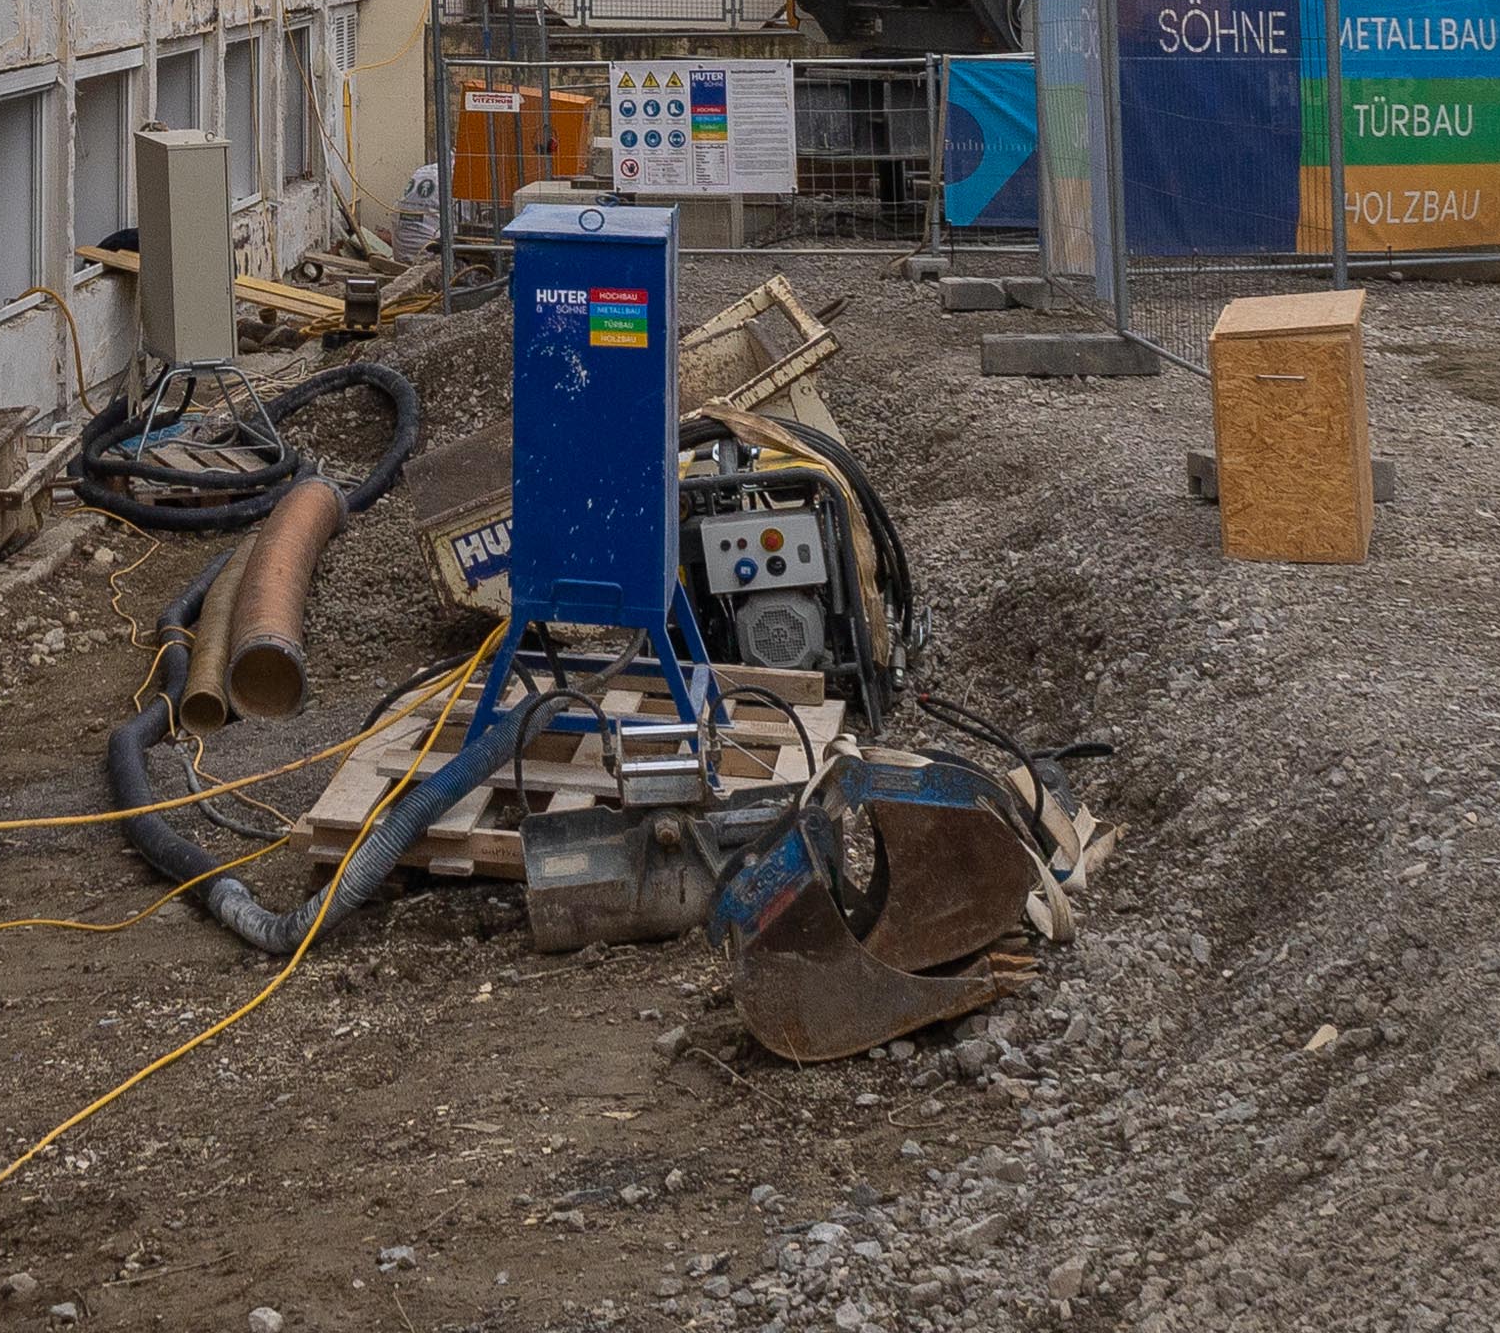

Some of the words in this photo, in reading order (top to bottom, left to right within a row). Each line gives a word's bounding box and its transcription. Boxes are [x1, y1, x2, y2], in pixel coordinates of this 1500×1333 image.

[691, 72, 724, 81] HUTER
[1353, 95, 1474, 137] TÜRBAU
[1344, 189, 1480, 225] HOLZBAU
[536, 289, 587, 304] HUTER
[599, 292, 637, 301] HOCHBAU
[556, 304, 588, 315] SÖHNE
[597, 306, 641, 315] METALLBAU
[604, 319, 634, 329] TÜRBAU
[455, 519, 513, 568] HU
